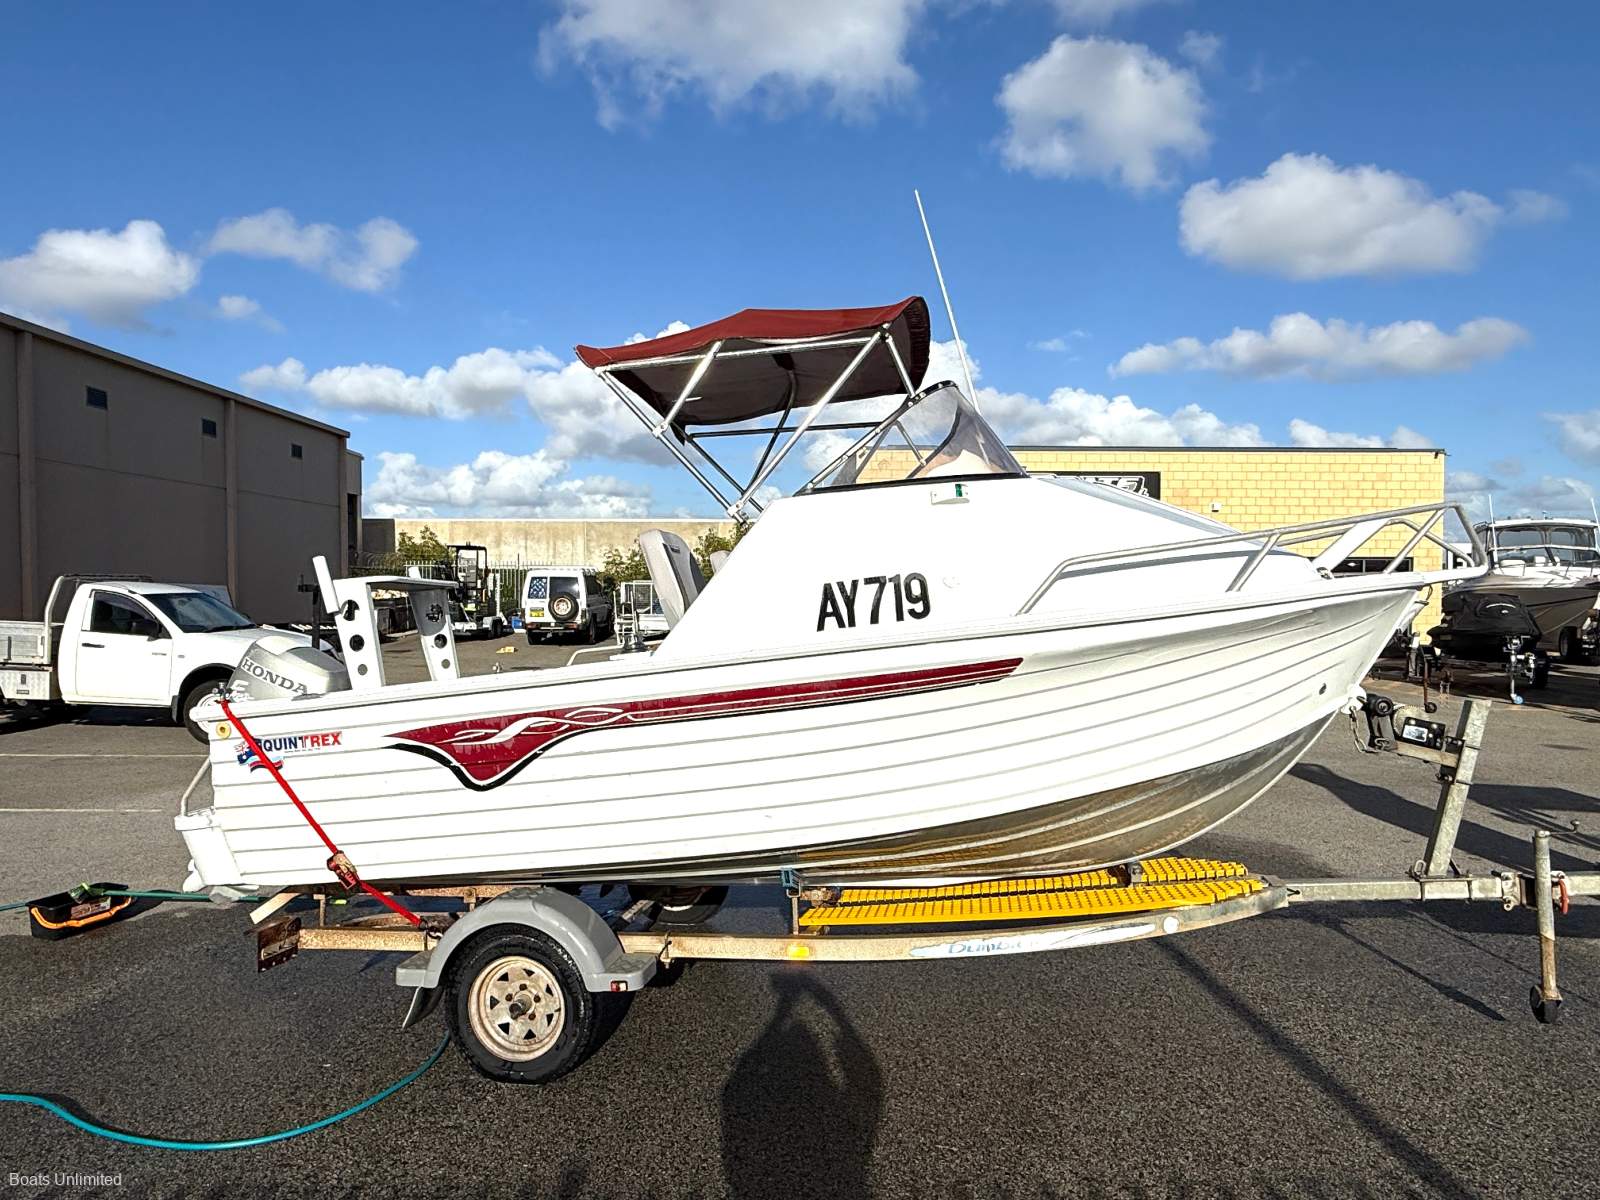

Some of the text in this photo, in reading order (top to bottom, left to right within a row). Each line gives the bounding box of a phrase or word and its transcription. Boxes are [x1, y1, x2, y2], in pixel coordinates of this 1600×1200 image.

[816, 572, 931, 632] AY719
[242, 658, 308, 695] HONDA
[262, 731, 342, 752] QUINTREX
